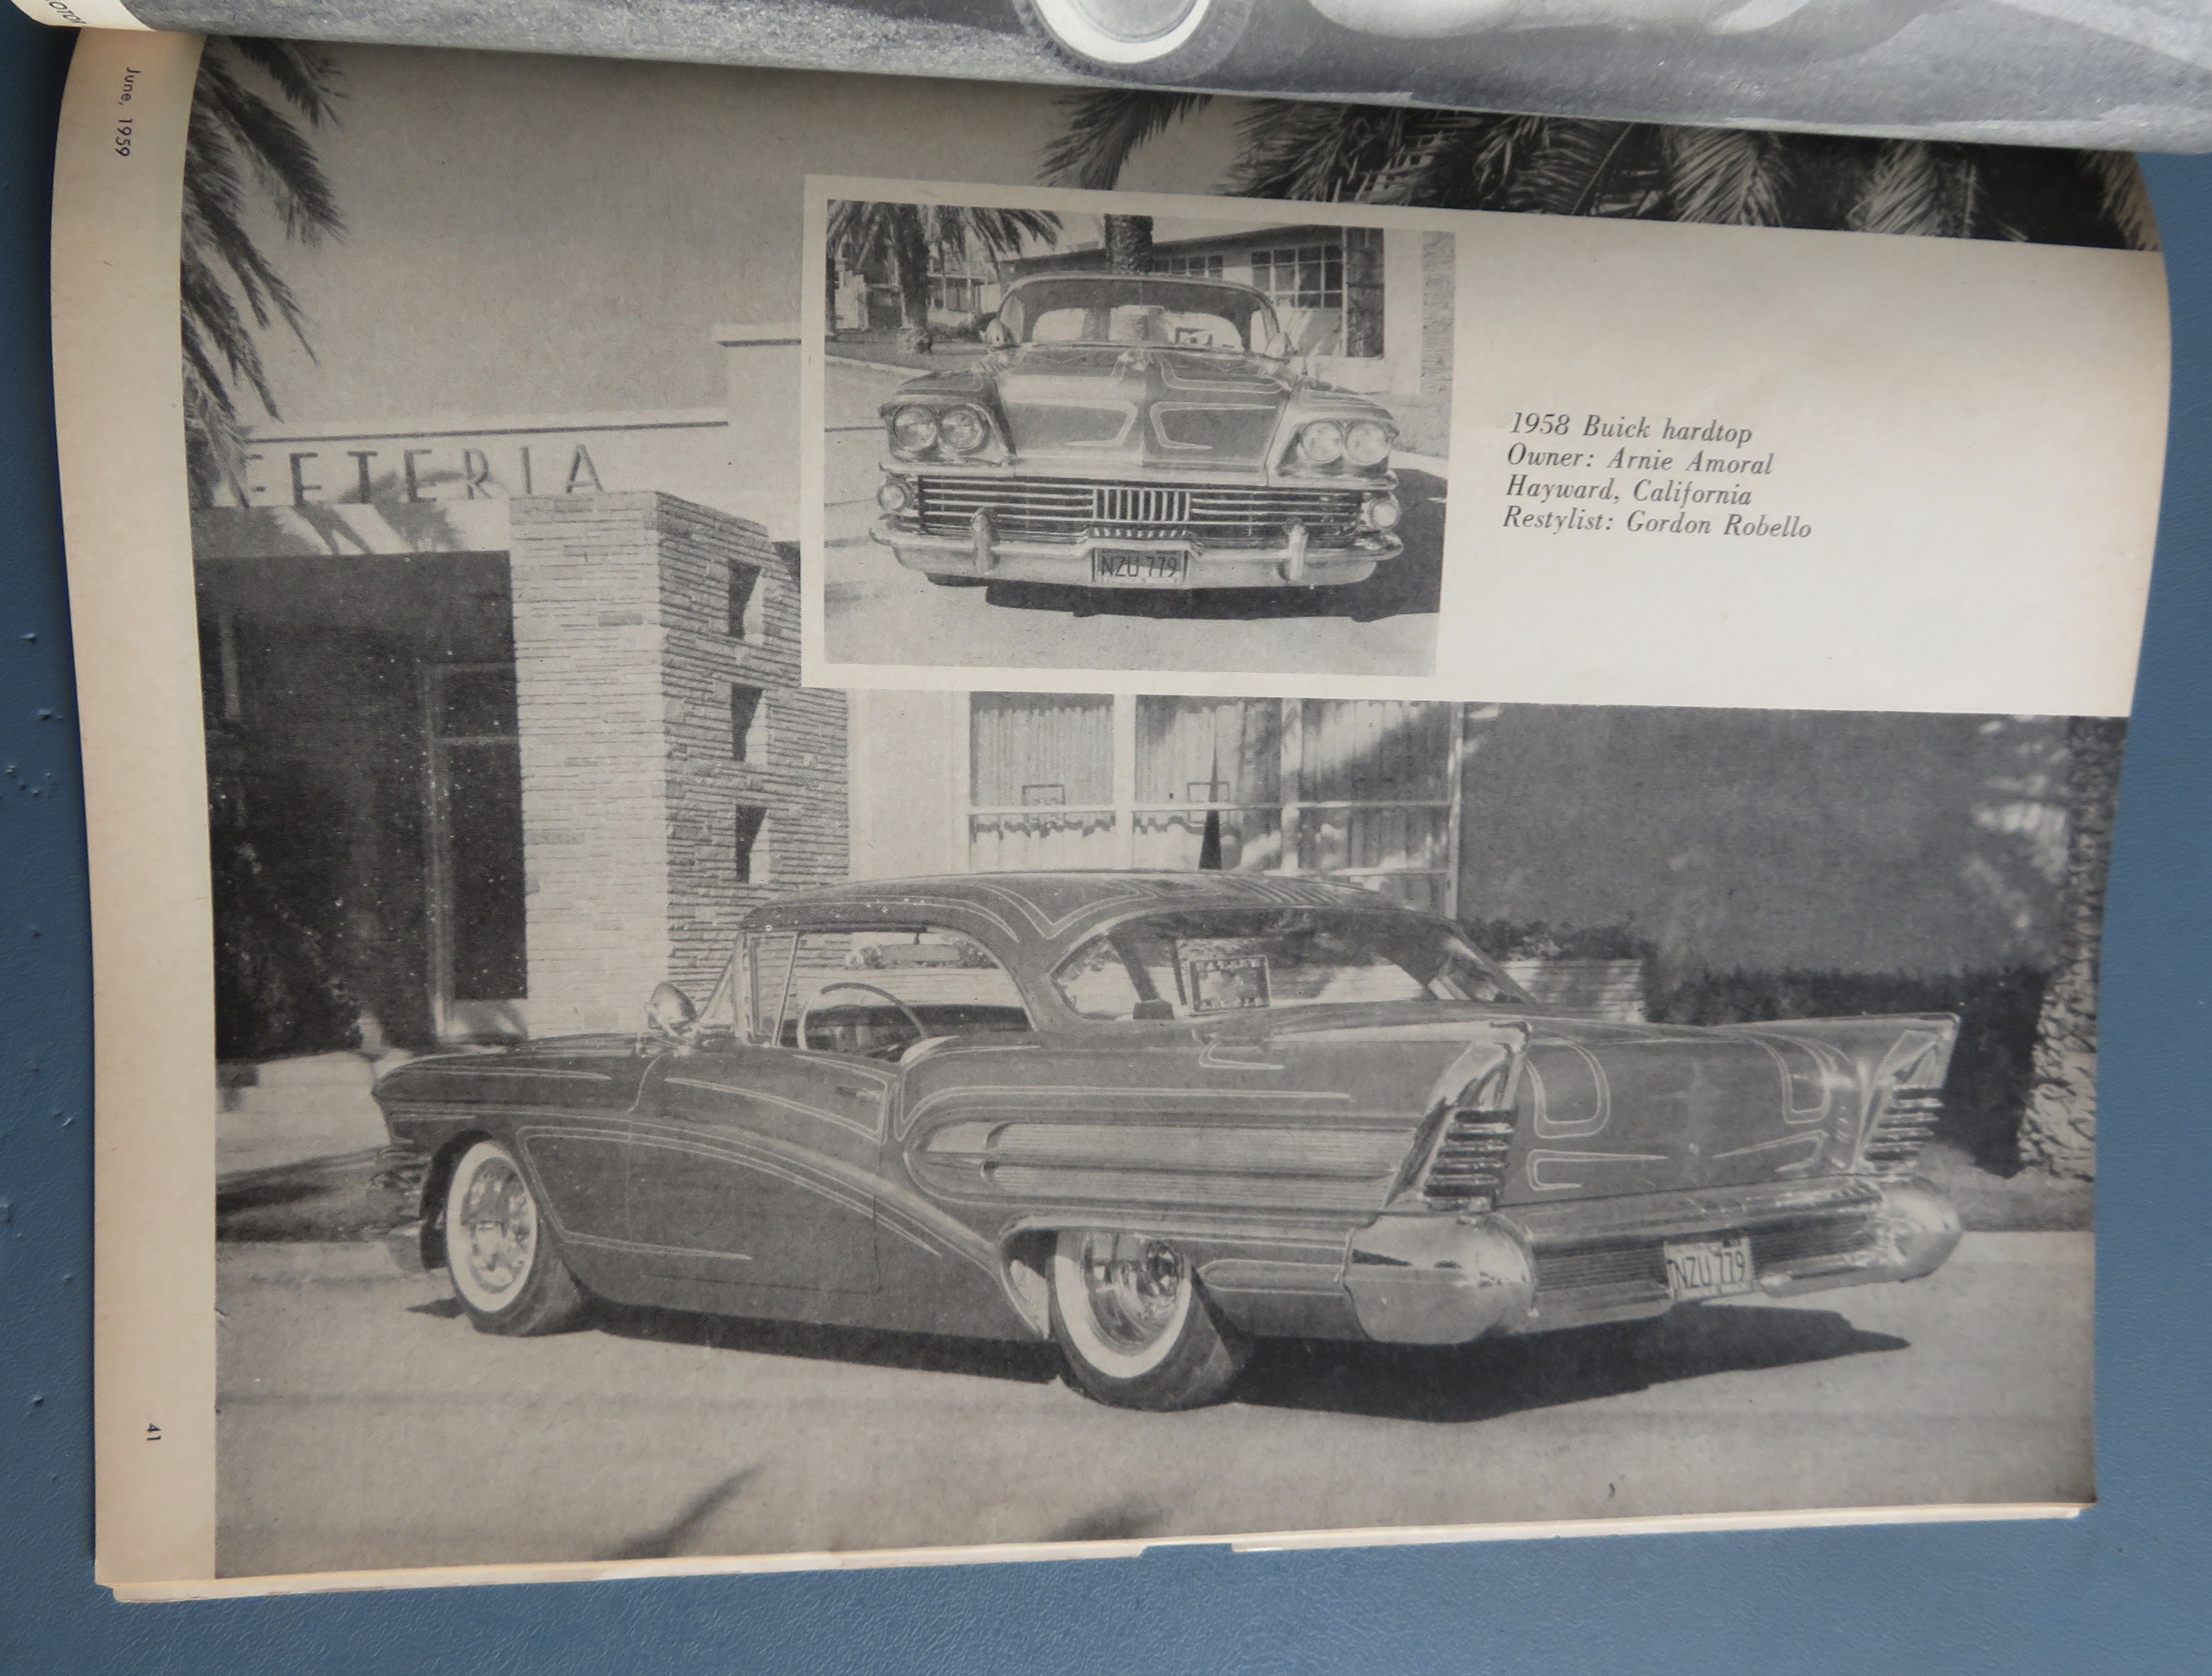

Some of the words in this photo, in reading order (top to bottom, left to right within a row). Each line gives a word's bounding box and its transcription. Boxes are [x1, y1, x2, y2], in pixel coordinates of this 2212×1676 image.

[118, 66, 141, 106] June,
[114, 118, 133, 156] 1959
[1510, 412, 1570, 435] 1958
[1583, 414, 1651, 438] Buick
[1661, 417, 1753, 447] hardtop
[1507, 443, 1595, 468] Owner:
[1606, 447, 1674, 471] Arnie
[1684, 451, 1775, 475] Amoral
[1505, 474, 1620, 503] Hayward,
[1633, 478, 1753, 508] California
[1502, 505, 1614, 535] Restylist:
[1627, 510, 1711, 534] Gordon
[1722, 513, 1812, 538] Robello
[1101, 556, 1139, 577] NZU
[1146, 557, 1178, 578] 779
[1673, 1254, 1712, 1290] NZU
[1713, 1250, 1746, 1286] 779
[146, 1422, 162, 1440] 41
